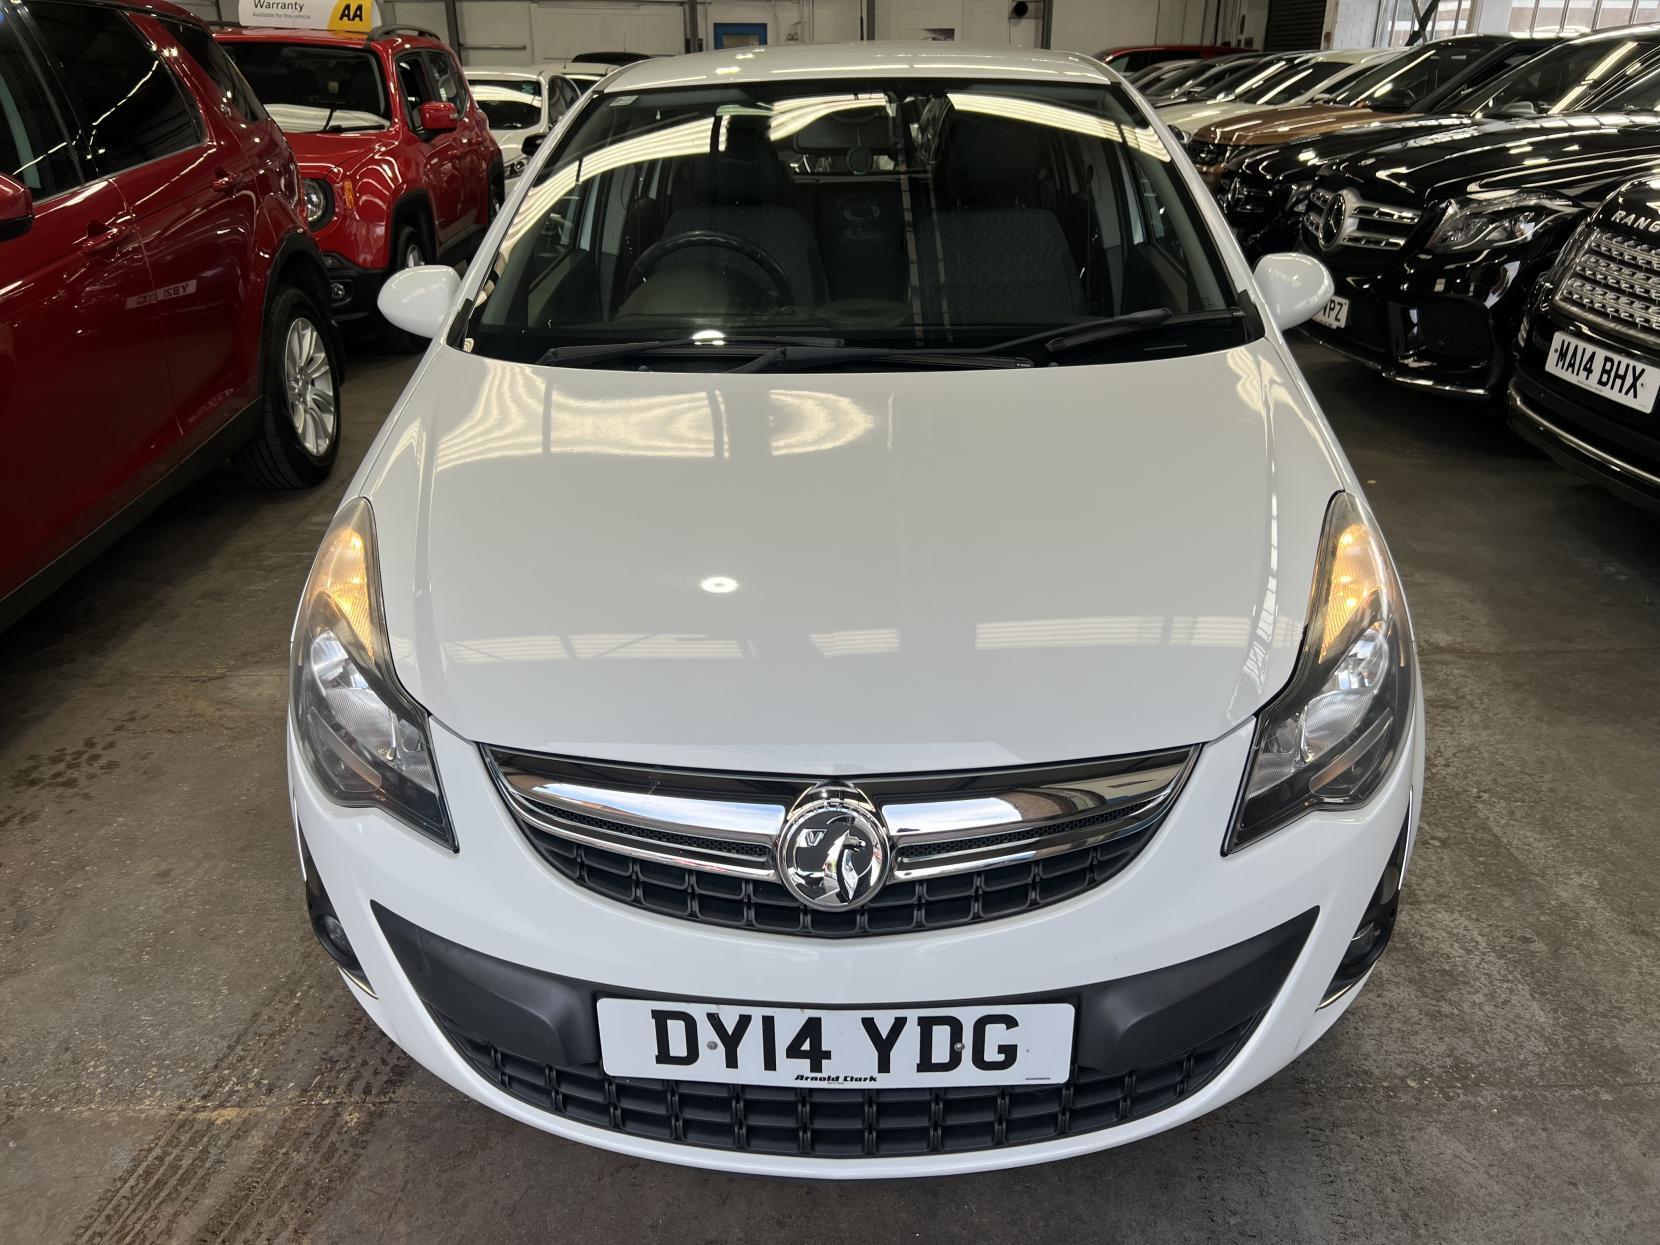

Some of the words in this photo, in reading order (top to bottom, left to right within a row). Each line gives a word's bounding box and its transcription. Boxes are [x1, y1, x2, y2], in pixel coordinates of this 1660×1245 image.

[253, 0, 305, 13] Warranty
[339, 3, 363, 22] AA
[1555, 339, 1597, 380] MA14
[1597, 355, 1646, 399] BHX
[650, 1009, 832, 1074] DY14
[860, 1013, 1020, 1074] YDG
[794, 1074, 840, 1082] Arnold
